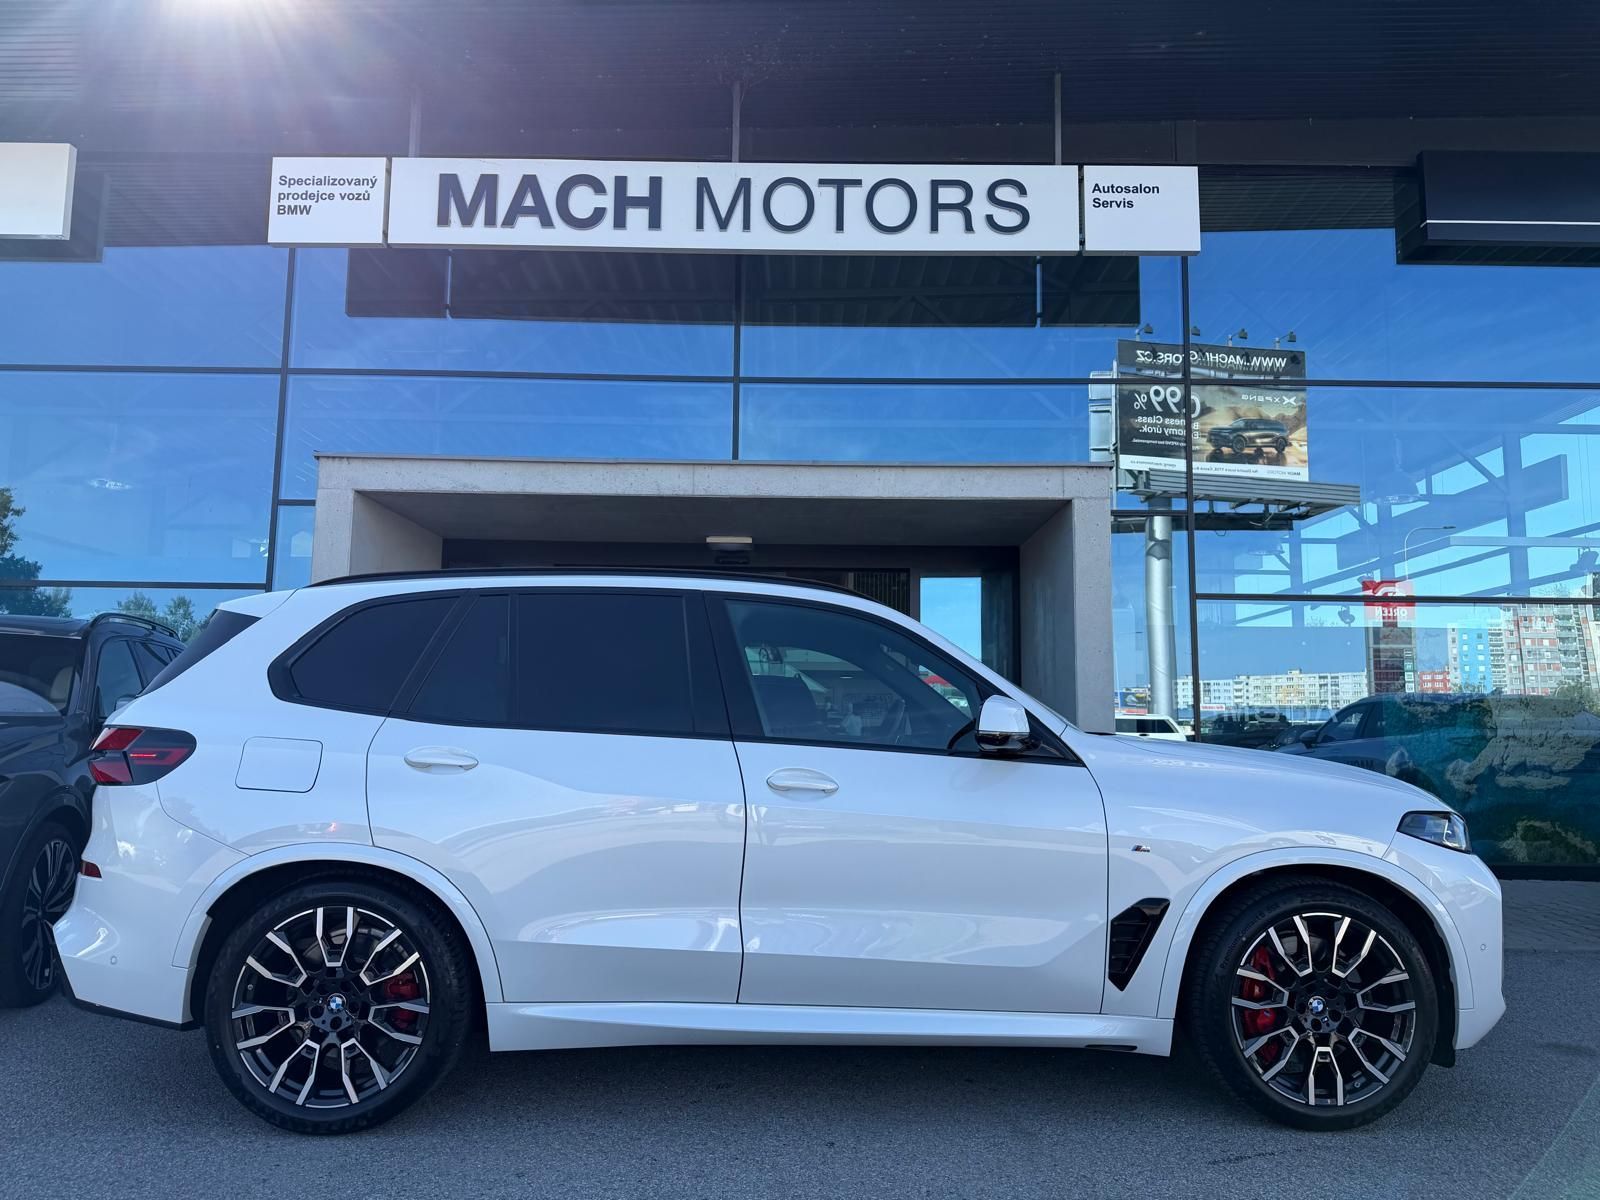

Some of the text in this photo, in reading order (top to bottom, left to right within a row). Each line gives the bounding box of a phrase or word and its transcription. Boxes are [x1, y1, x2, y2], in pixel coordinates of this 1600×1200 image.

[278, 175, 378, 189] Specializovaný
[1092, 182, 1160, 195] Autosalon
[277, 189, 371, 204] prodejce vozů
[1092, 197, 1135, 209] Servis
[276, 204, 313, 216] BMW
[437, 173, 1031, 236] MACH MOTORS
